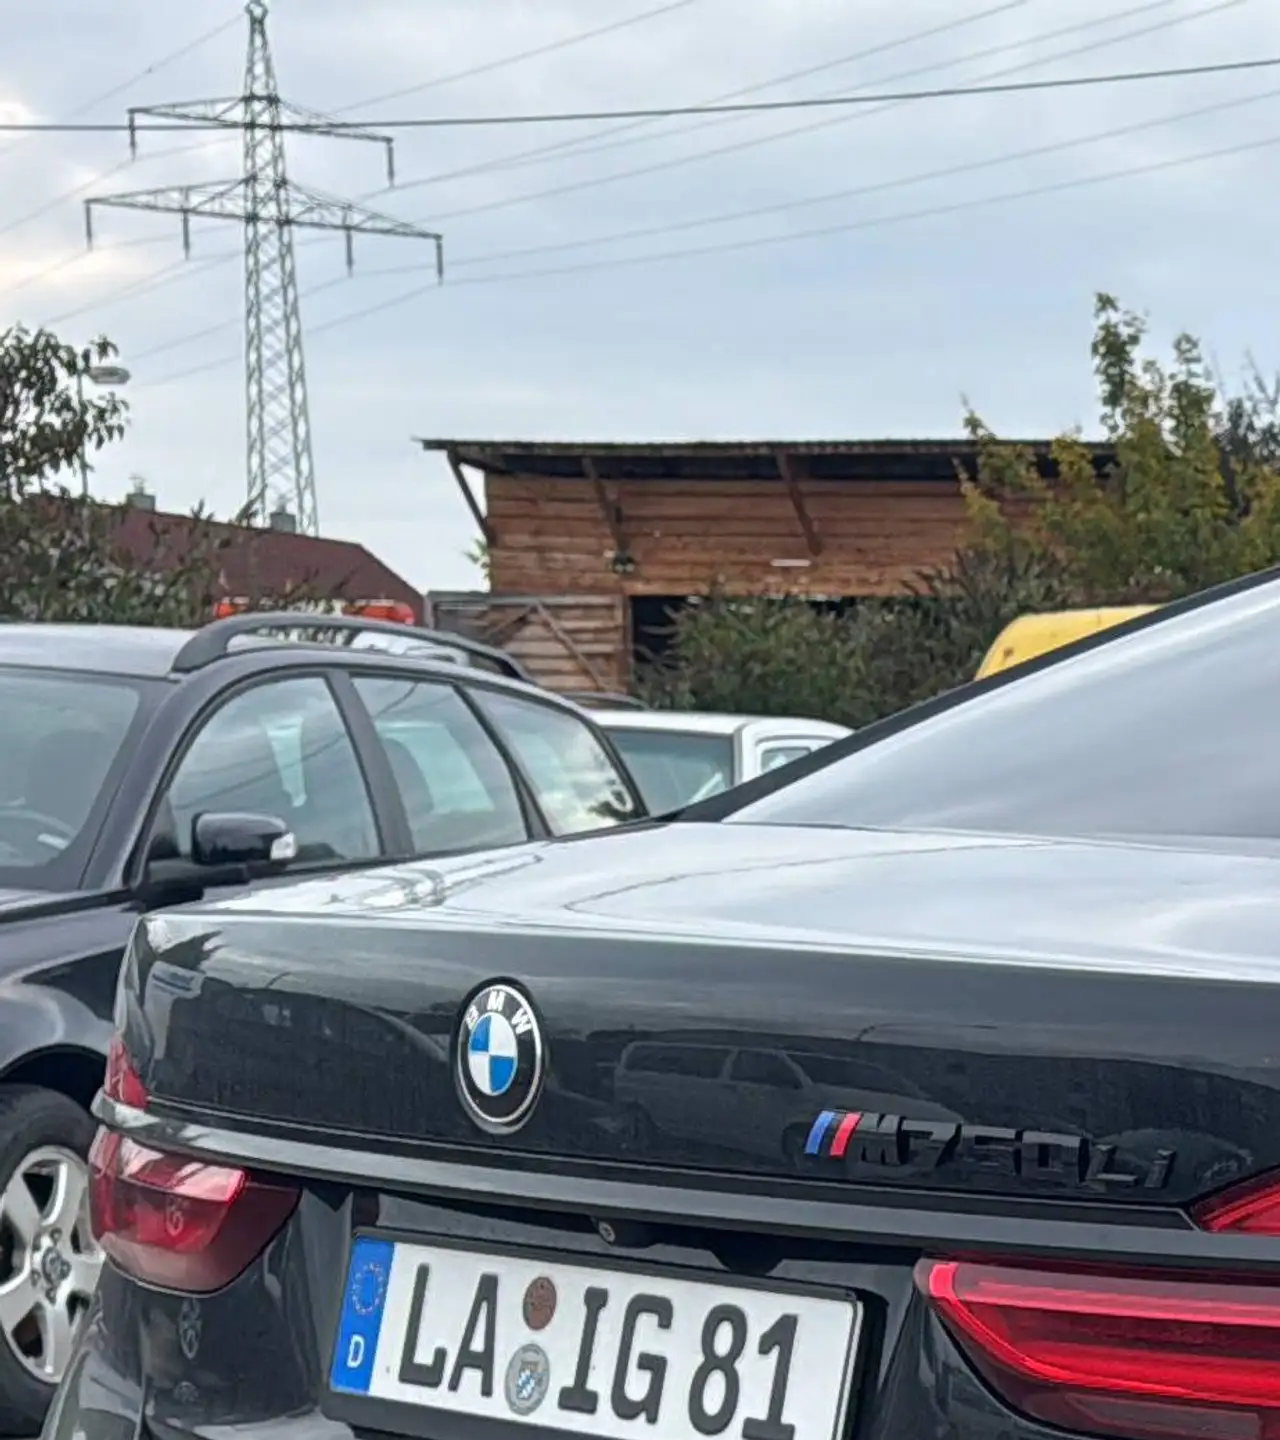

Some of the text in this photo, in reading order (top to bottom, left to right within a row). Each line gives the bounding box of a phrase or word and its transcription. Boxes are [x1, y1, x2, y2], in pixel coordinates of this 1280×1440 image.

[465, 990, 534, 1036] BMW
[346, 1334, 365, 1369] D
[398, 1263, 500, 1398] LA
[556, 1285, 676, 1426] IG
